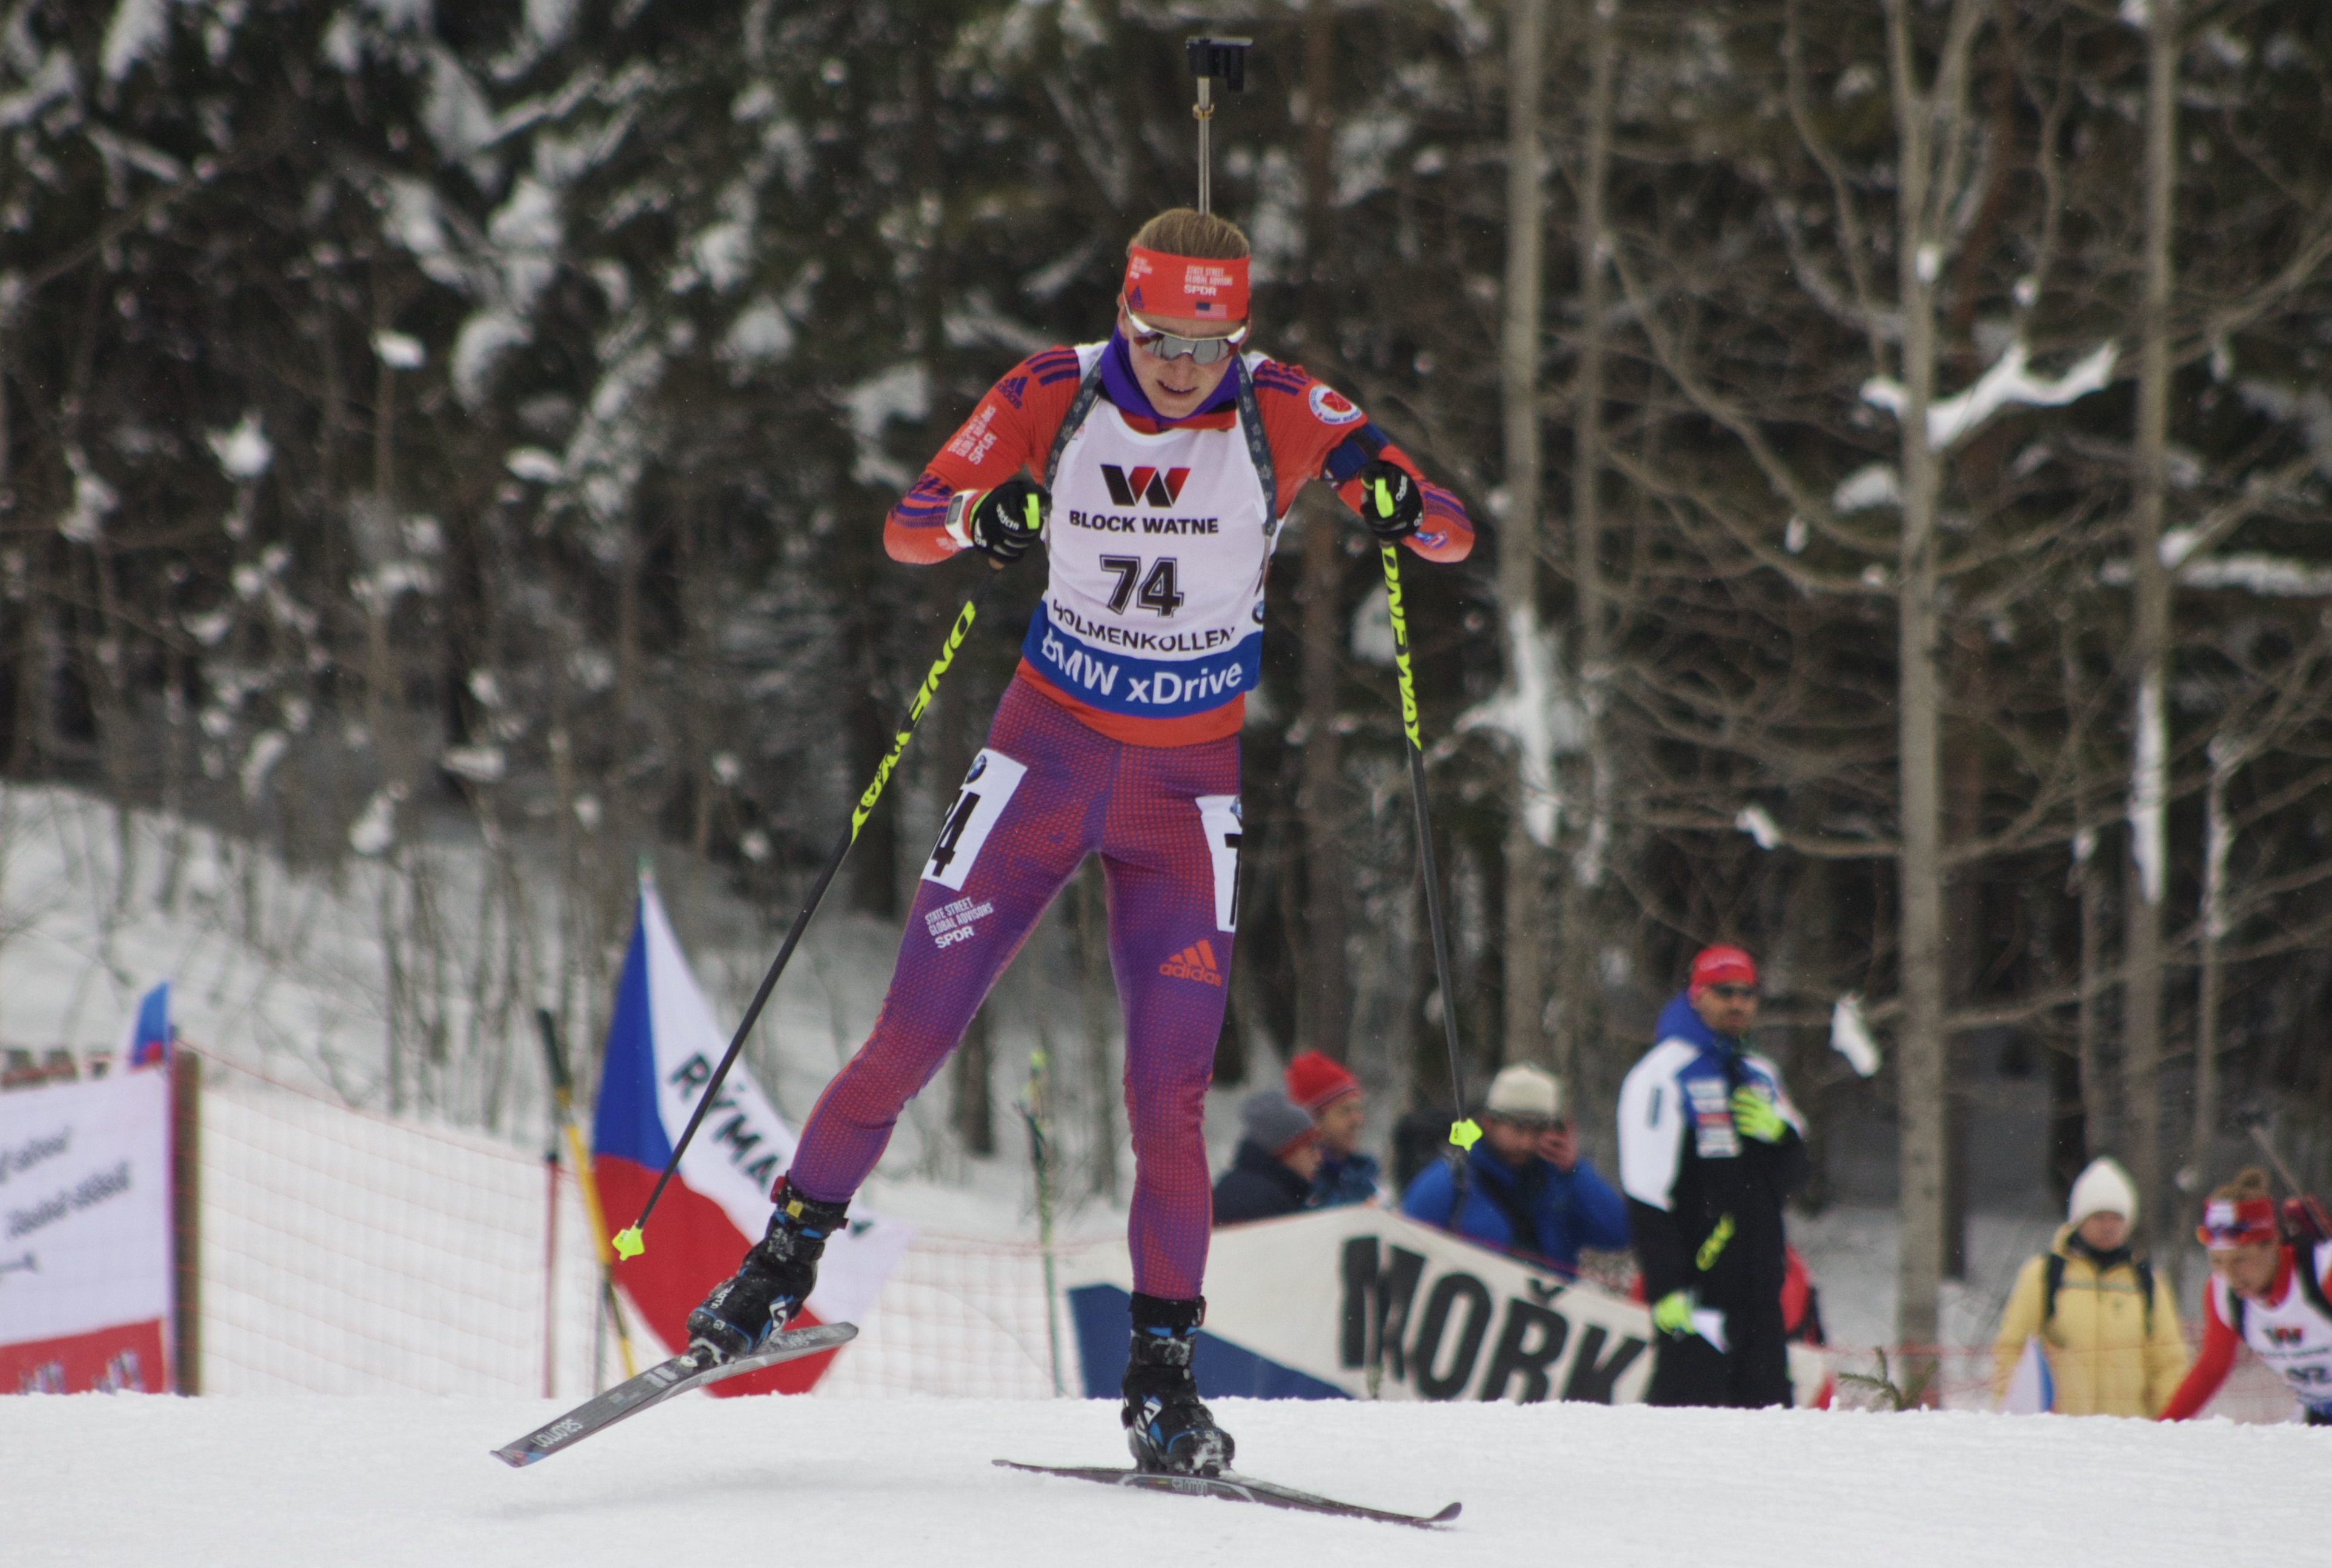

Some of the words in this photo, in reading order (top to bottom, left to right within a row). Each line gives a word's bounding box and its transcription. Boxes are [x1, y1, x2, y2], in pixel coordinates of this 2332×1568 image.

[1184, 285, 1217, 296] SPDR
[1069, 510, 1135, 533] BLOCK
[1143, 517, 1219, 535] WATNE
[1099, 554, 1184, 618] 74
[1041, 628, 1119, 696] BMW
[1125, 662, 1243, 704] xDrive
[1396, 653, 1421, 751] WAY
[925, 908, 946, 925] STATE
[944, 897, 973, 916] STREET
[928, 917, 957, 936] GLOBAL
[955, 902, 993, 925] ADVISORS
[935, 926, 974, 949] SPDR
[1158, 962, 1222, 988] adidas
